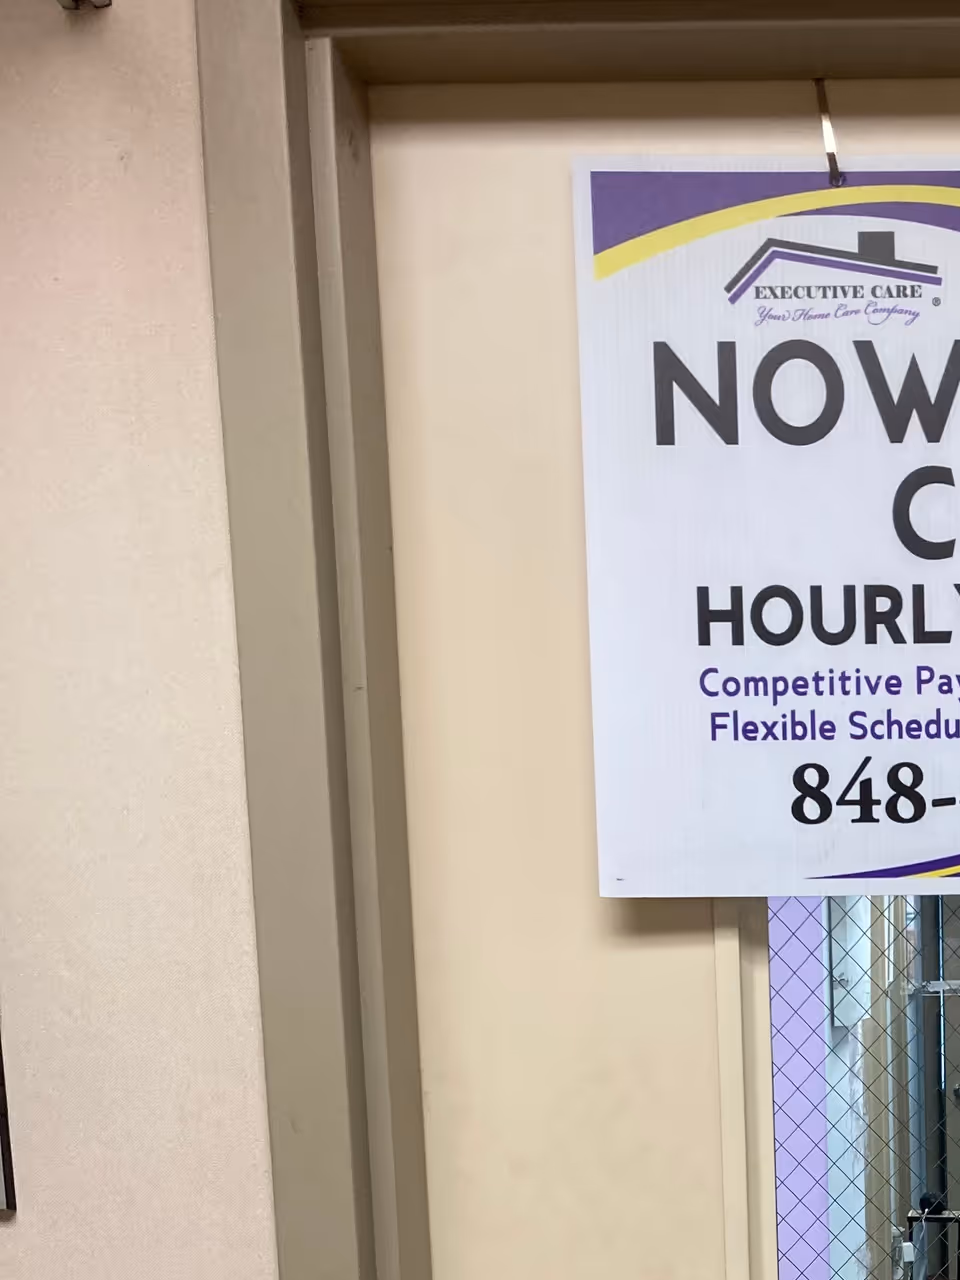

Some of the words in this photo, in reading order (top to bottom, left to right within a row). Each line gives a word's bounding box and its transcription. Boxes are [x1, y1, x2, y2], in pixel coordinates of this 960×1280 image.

[754, 285, 865, 300] EXECUTIVE
[870, 284, 923, 299] CARE
[754, 305, 790, 327] Your
[791, 307, 831, 322] Home
[834, 303, 861, 319] Care
[864, 300, 921, 326] Company
[699, 665, 903, 707] Competitive
[710, 711, 837, 742] Flexible
